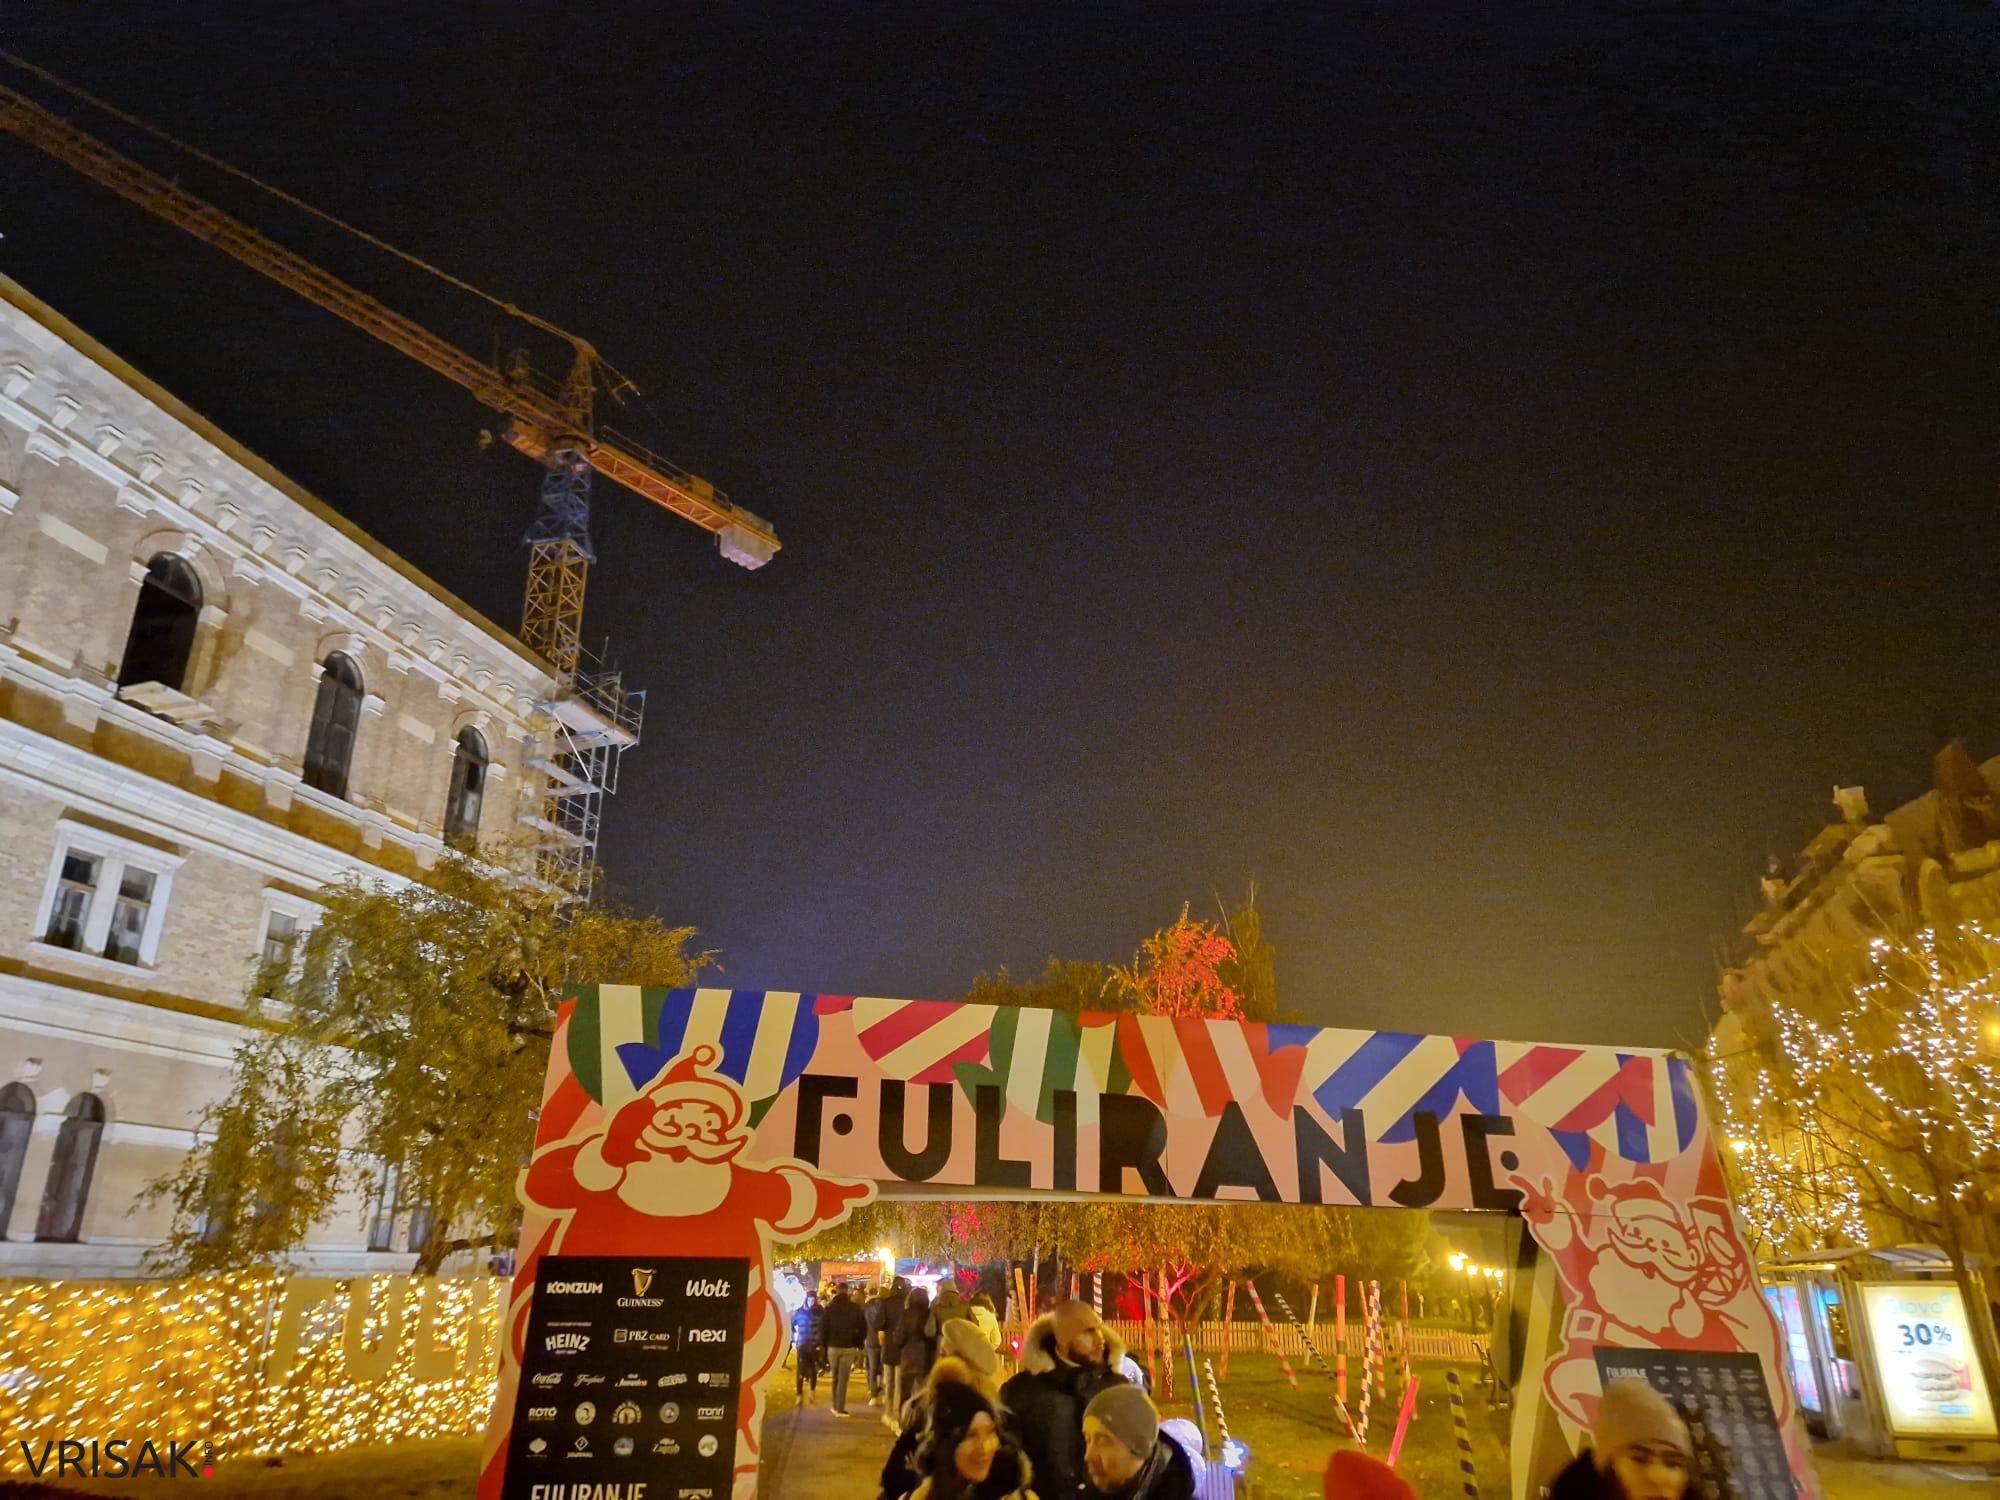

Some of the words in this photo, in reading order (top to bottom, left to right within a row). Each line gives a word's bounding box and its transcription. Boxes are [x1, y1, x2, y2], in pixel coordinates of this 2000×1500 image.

[794, 1073, 1523, 1209] FULIRANJE
[546, 1281, 604, 1295] KONZUM
[685, 1279, 731, 1298] Wolt
[616, 1297, 664, 1308] GUINNESS
[545, 1333, 591, 1351] HEINZ
[628, 1331, 649, 1341] PBZ
[688, 1329, 727, 1343] nexi
[1897, 1323, 1953, 1346] 30%
